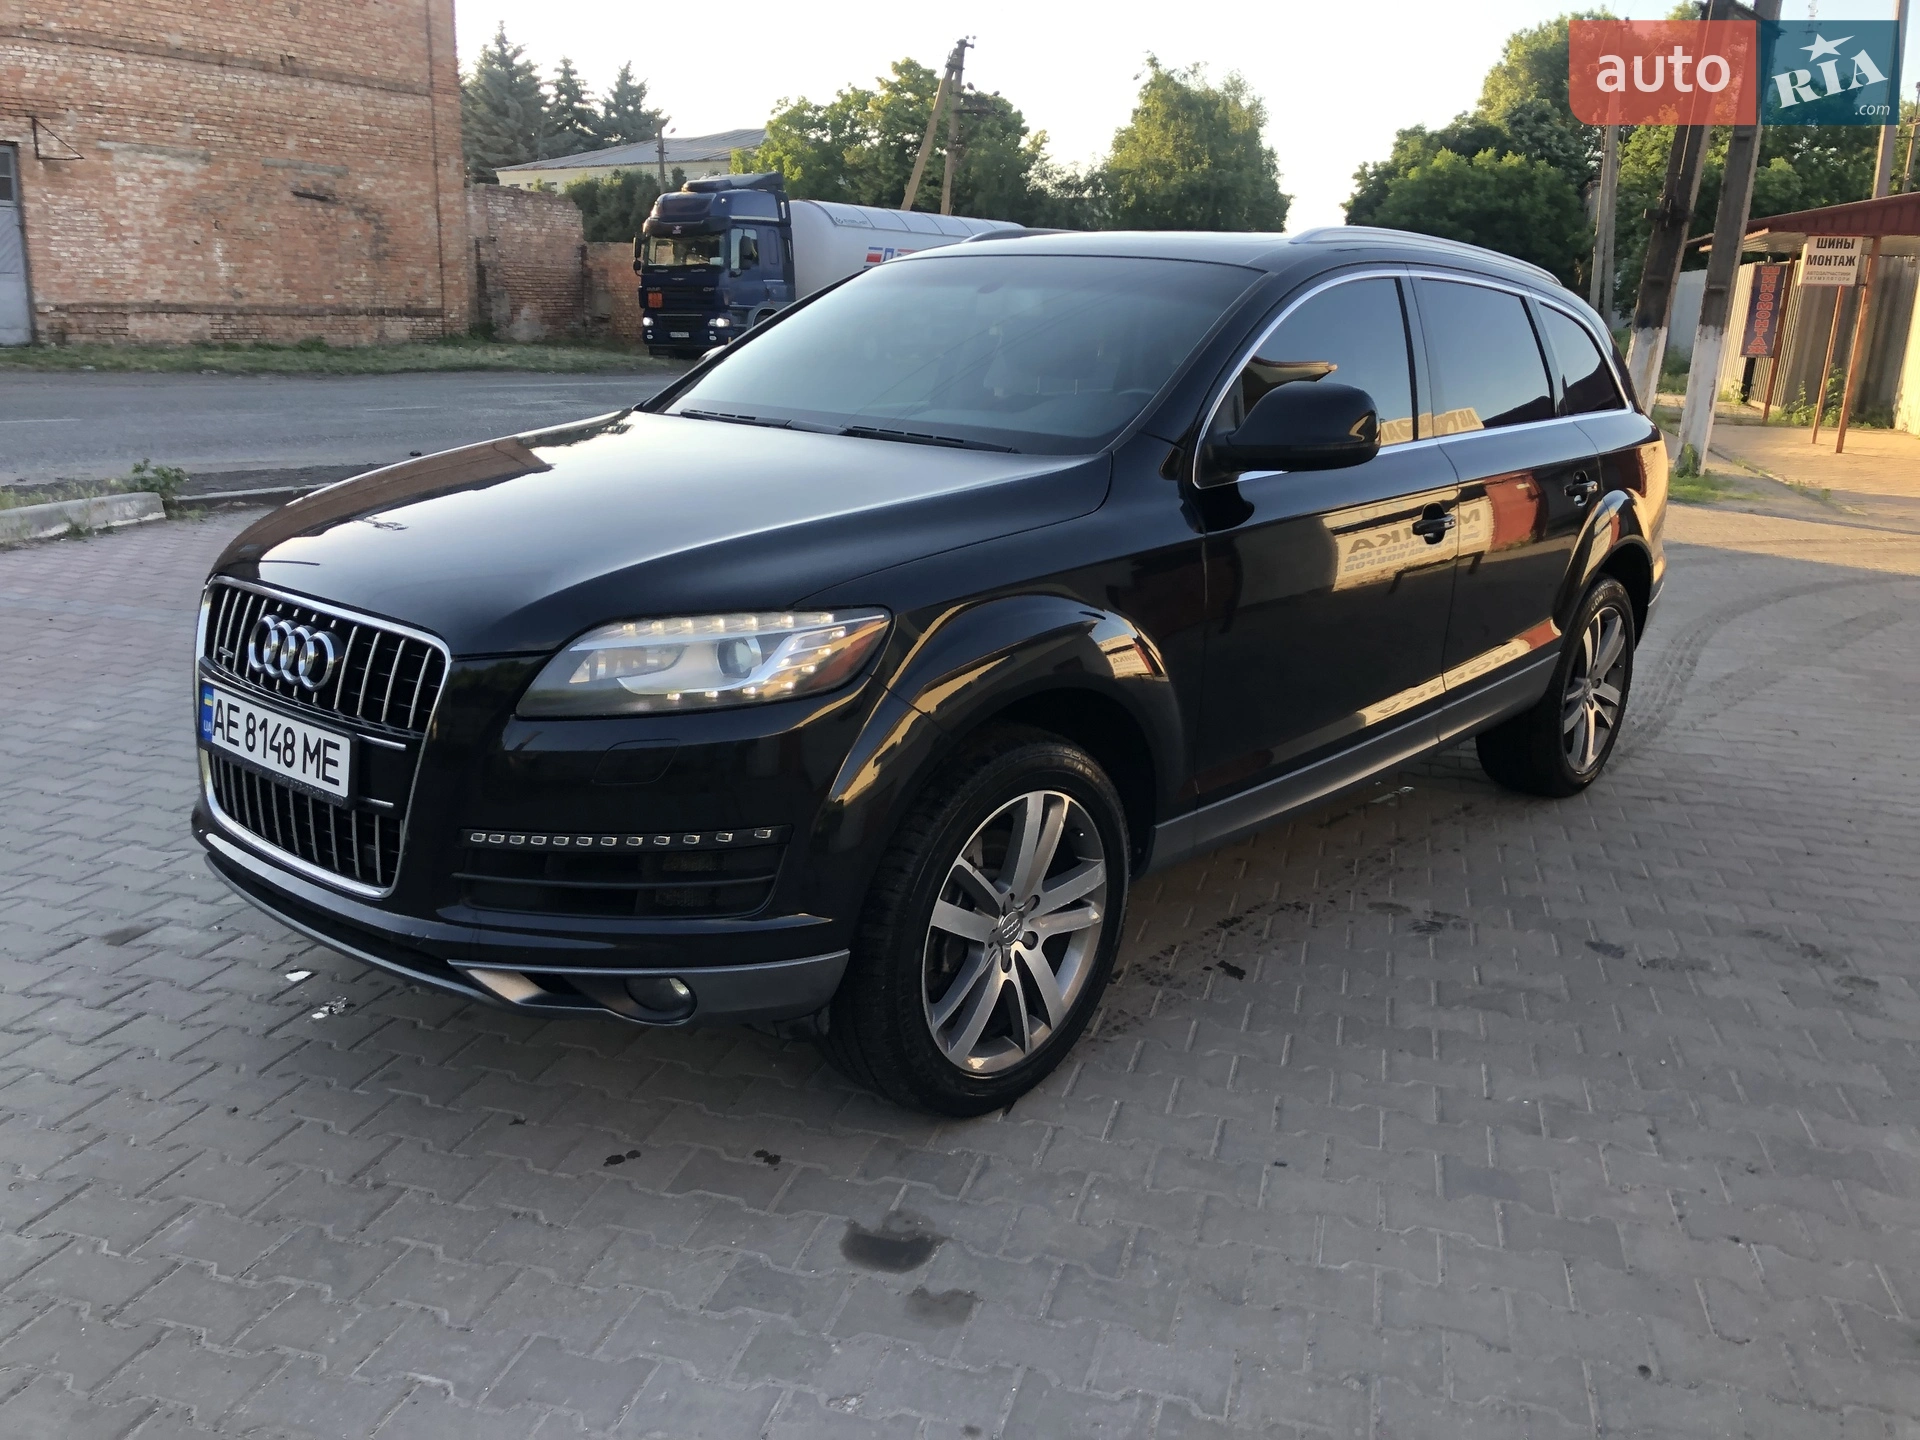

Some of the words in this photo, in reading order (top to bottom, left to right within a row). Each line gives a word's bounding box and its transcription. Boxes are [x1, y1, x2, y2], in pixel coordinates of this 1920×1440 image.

[1806, 254, 1857, 267] МОНТАЖ
[1816, 237, 1856, 249] ШИНЫ
[1746, 265, 1781, 355] ШИНОМОНТАЖ
[213, 698, 240, 747] AE
[245, 711, 296, 768] 8148
[302, 732, 340, 786] ME
